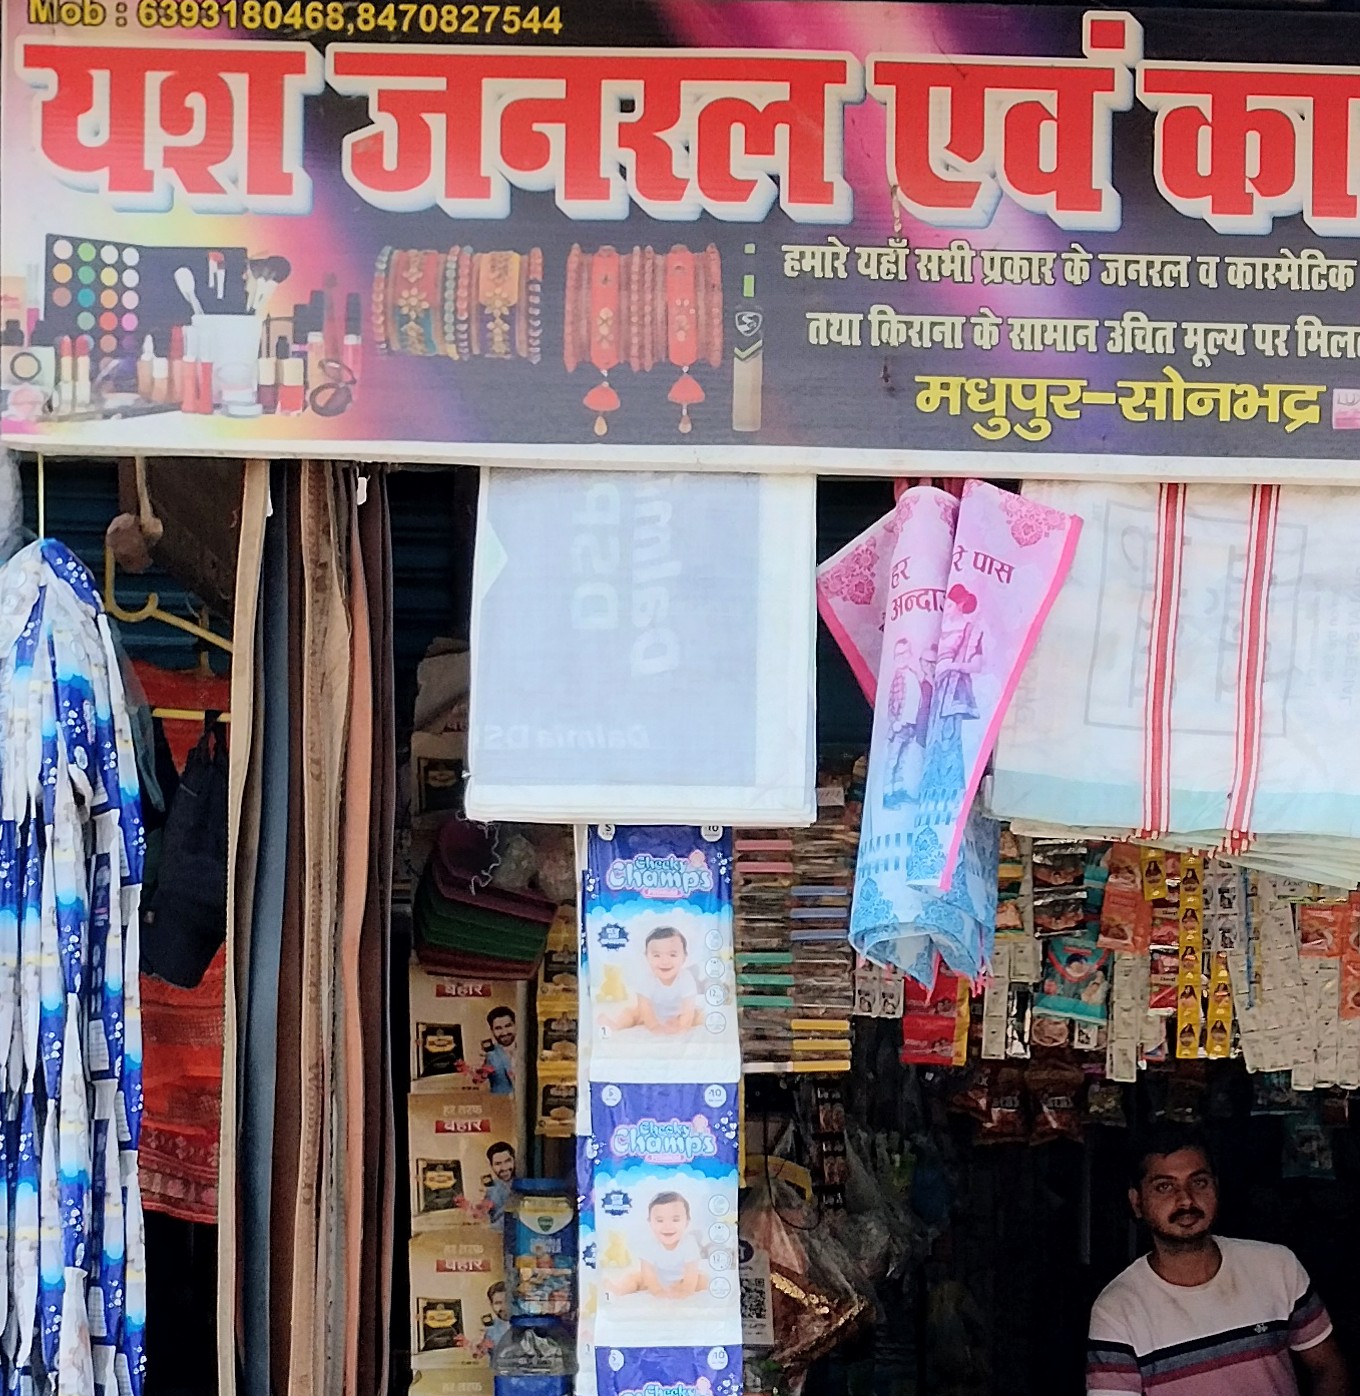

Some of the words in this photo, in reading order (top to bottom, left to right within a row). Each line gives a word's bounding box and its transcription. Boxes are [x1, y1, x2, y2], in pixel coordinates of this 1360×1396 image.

[28, 0, 105, 26] Mob
[136, 0, 564, 35] 6393180468,8470827544
[22, 42, 312, 200] यश
[332, 48, 852, 210] जनरल
[870, 17, 1132, 216] एवं
[781, 237, 850, 279] हमारे
[855, 238, 910, 280] यहाँ
[915, 239, 977, 284] सभी
[981, 250, 1056, 286] प्रकार
[1061, 244, 1094, 285] के
[1099, 253, 1192, 289] जनरल
[1196, 256, 1220, 289] व
[806, 311, 864, 347] तथा
[868, 305, 966, 350] किराना
[969, 307, 1003, 351] के
[1007, 317, 1100, 352] सामान
[1104, 311, 1178, 354] उचित
[1182, 322, 1249, 368] मूल्य
[1253, 323, 1290, 357] पर
[890, 555, 912, 590] हर
[972, 550, 1016, 585] पास
[890, 588, 947, 622] अन्दा
[607, 861, 712, 893] Champs
[613, 1127, 717, 1157] Champs
